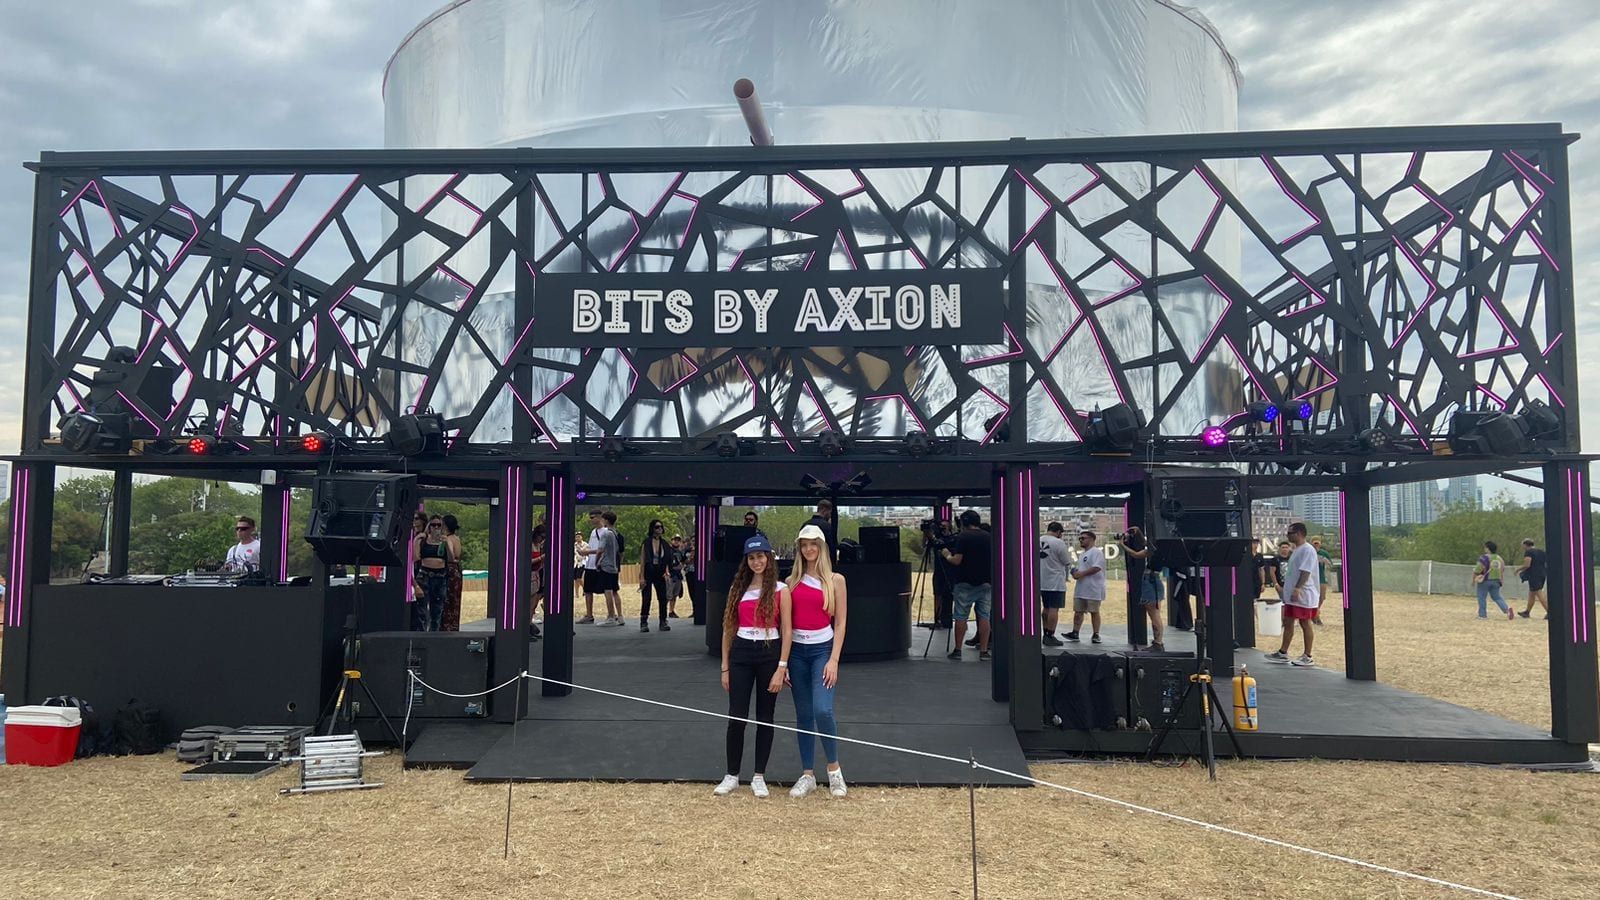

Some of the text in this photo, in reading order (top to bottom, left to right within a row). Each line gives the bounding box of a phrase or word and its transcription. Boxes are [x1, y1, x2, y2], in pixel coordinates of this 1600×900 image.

[573, 284, 961, 334] BITS BY AXION
